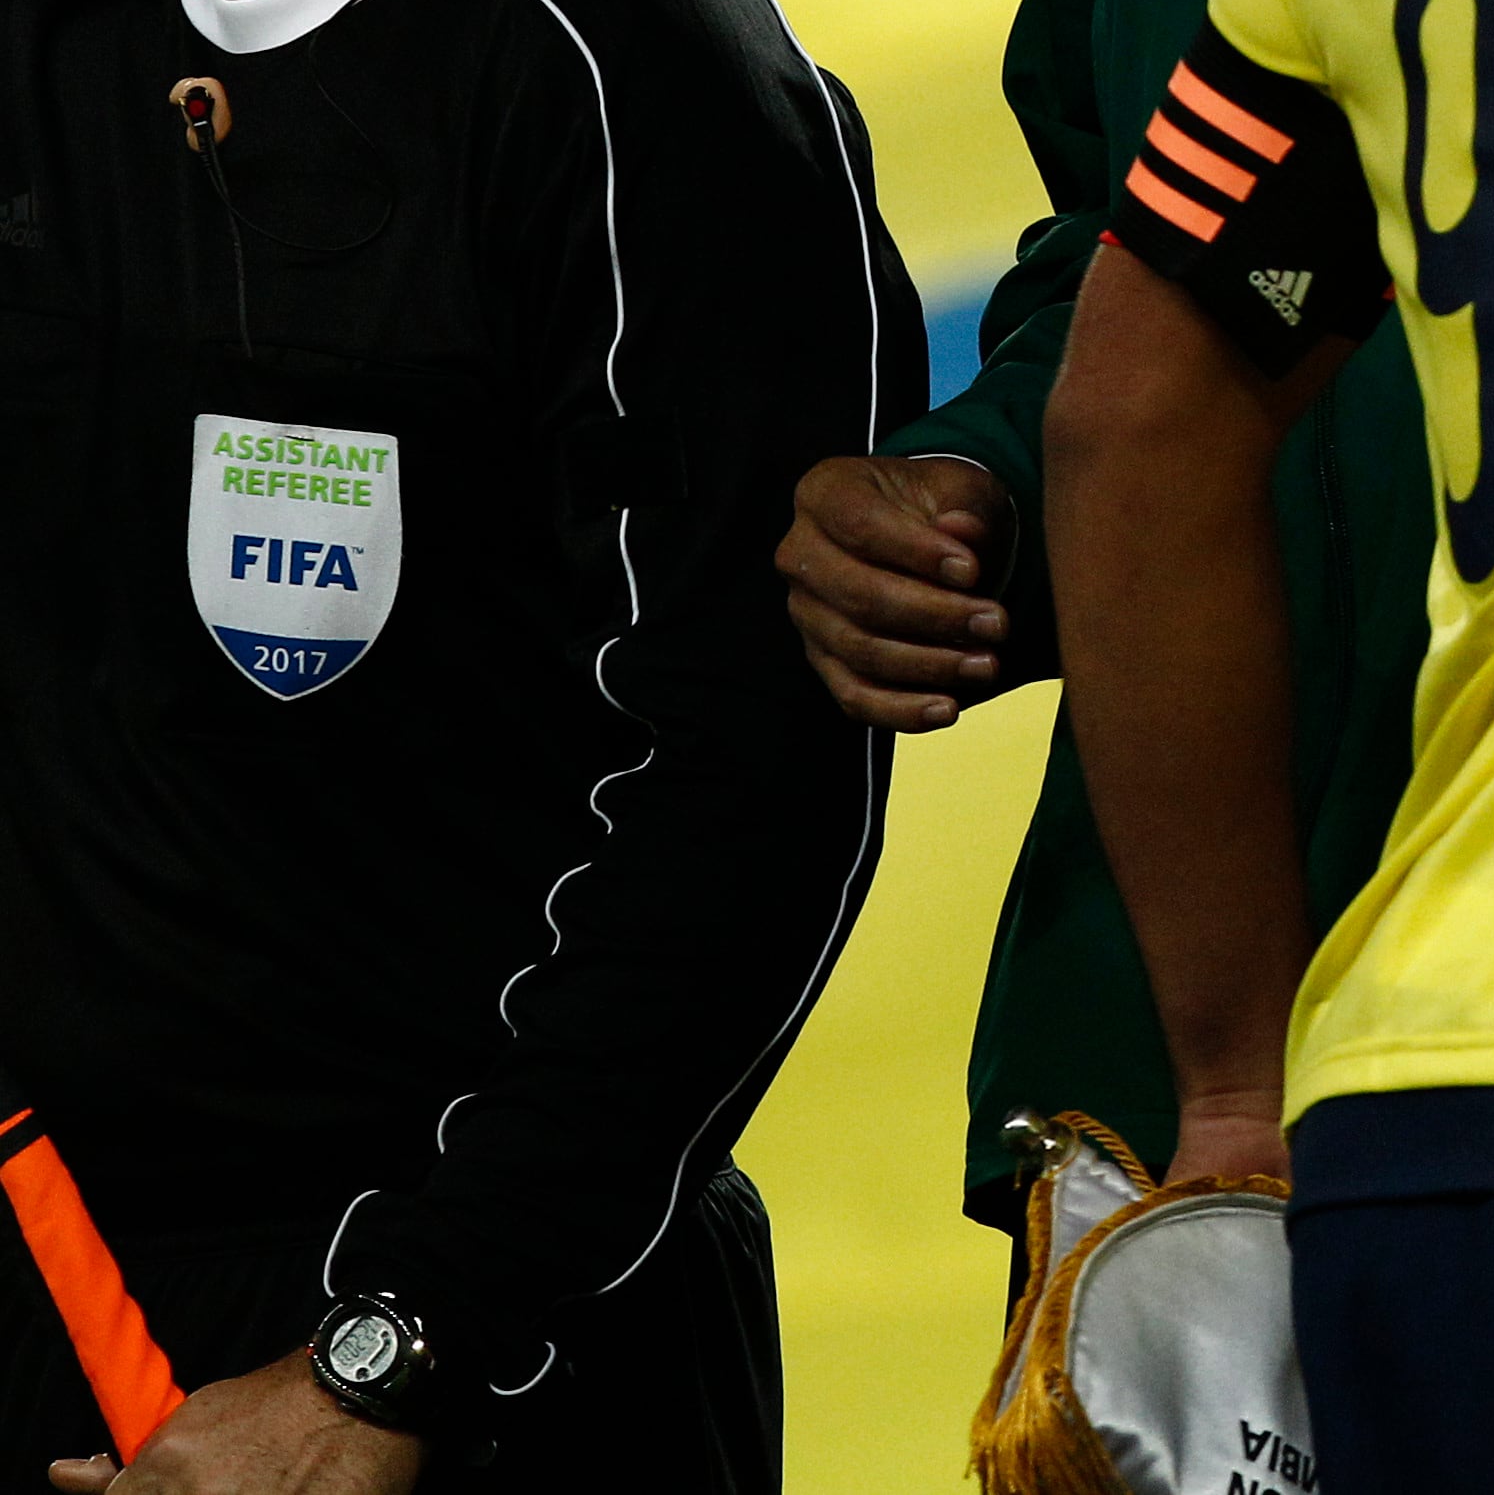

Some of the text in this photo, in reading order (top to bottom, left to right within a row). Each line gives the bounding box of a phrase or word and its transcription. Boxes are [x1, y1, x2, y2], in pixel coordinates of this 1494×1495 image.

[1249, 270, 1301, 326] adidas
[212, 432, 390, 474] ASSISTANT
[223, 466, 372, 507] REFEREE
[231, 534, 358, 591] FIFA
[253, 646, 328, 675] 2017
